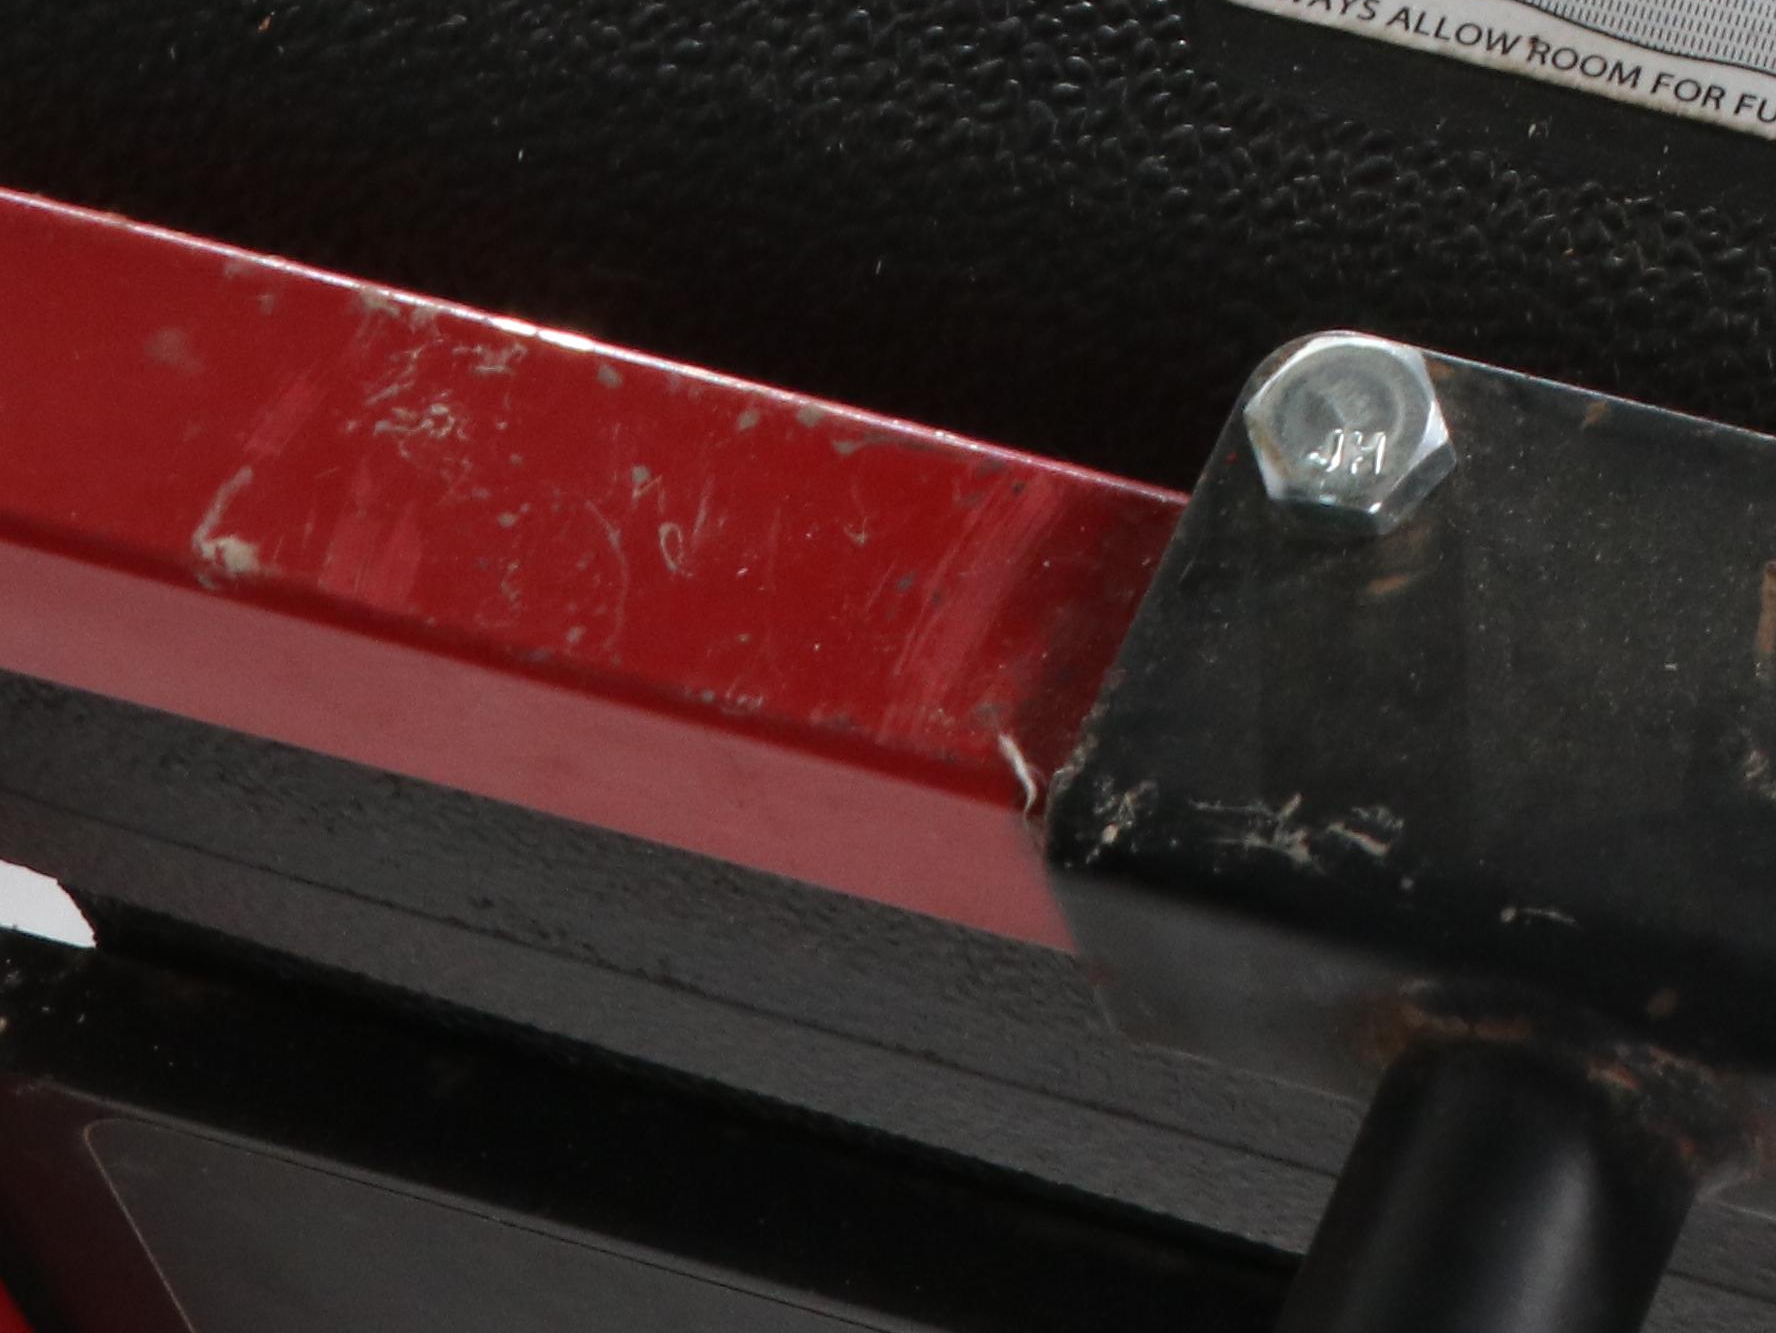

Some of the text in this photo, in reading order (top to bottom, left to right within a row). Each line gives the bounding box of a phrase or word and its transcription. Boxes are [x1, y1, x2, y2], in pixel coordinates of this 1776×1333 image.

[1385, 5, 1535, 61] ALLOW
[1525, 38, 1642, 89] ROOM
[1649, 71, 1726, 110] FOR
